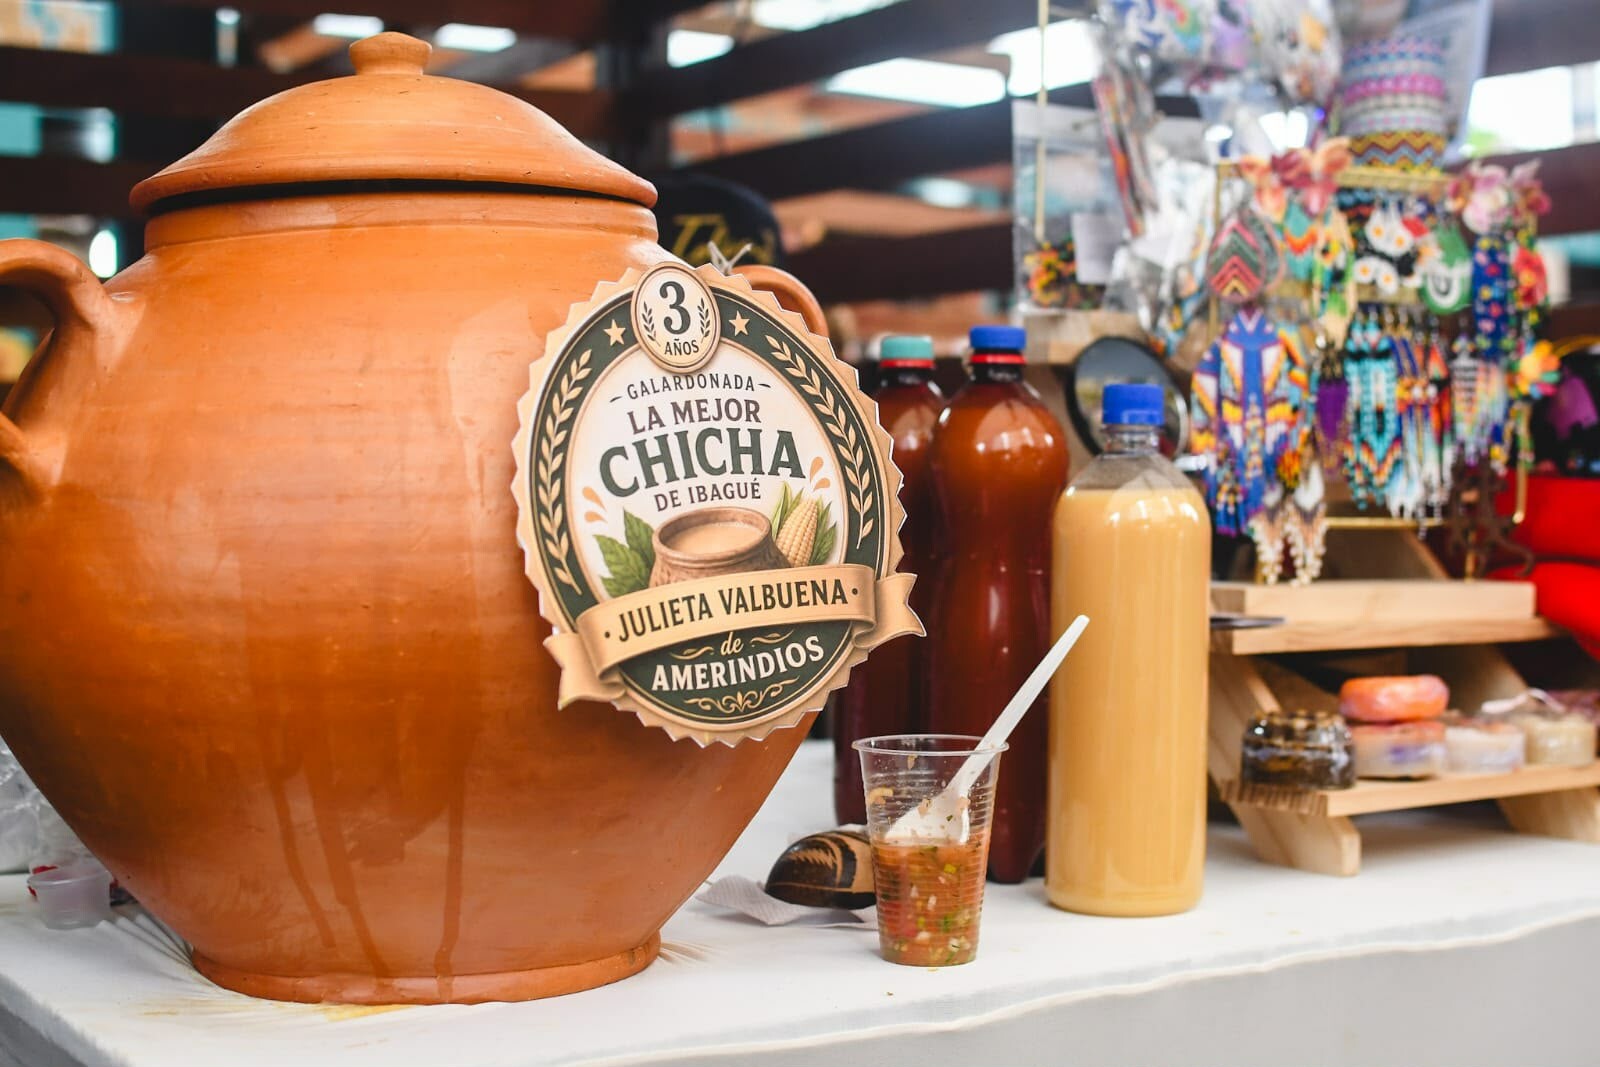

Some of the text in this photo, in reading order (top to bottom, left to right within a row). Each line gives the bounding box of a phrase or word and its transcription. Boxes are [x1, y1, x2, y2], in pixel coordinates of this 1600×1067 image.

[659, 280, 692, 336] 3
[664, 338, 700, 356] AÑOS
[627, 373, 756, 401] GALARDONADA
[627, 397, 762, 436] LA MEJOR
[599, 427, 806, 498] CHICHA
[654, 477, 762, 513] DE IBAGUÉ
[618, 578, 849, 643] JULIETA VALBUENA
[651, 635, 825, 692] AMERINDIOS
[720, 631, 744, 657] de
